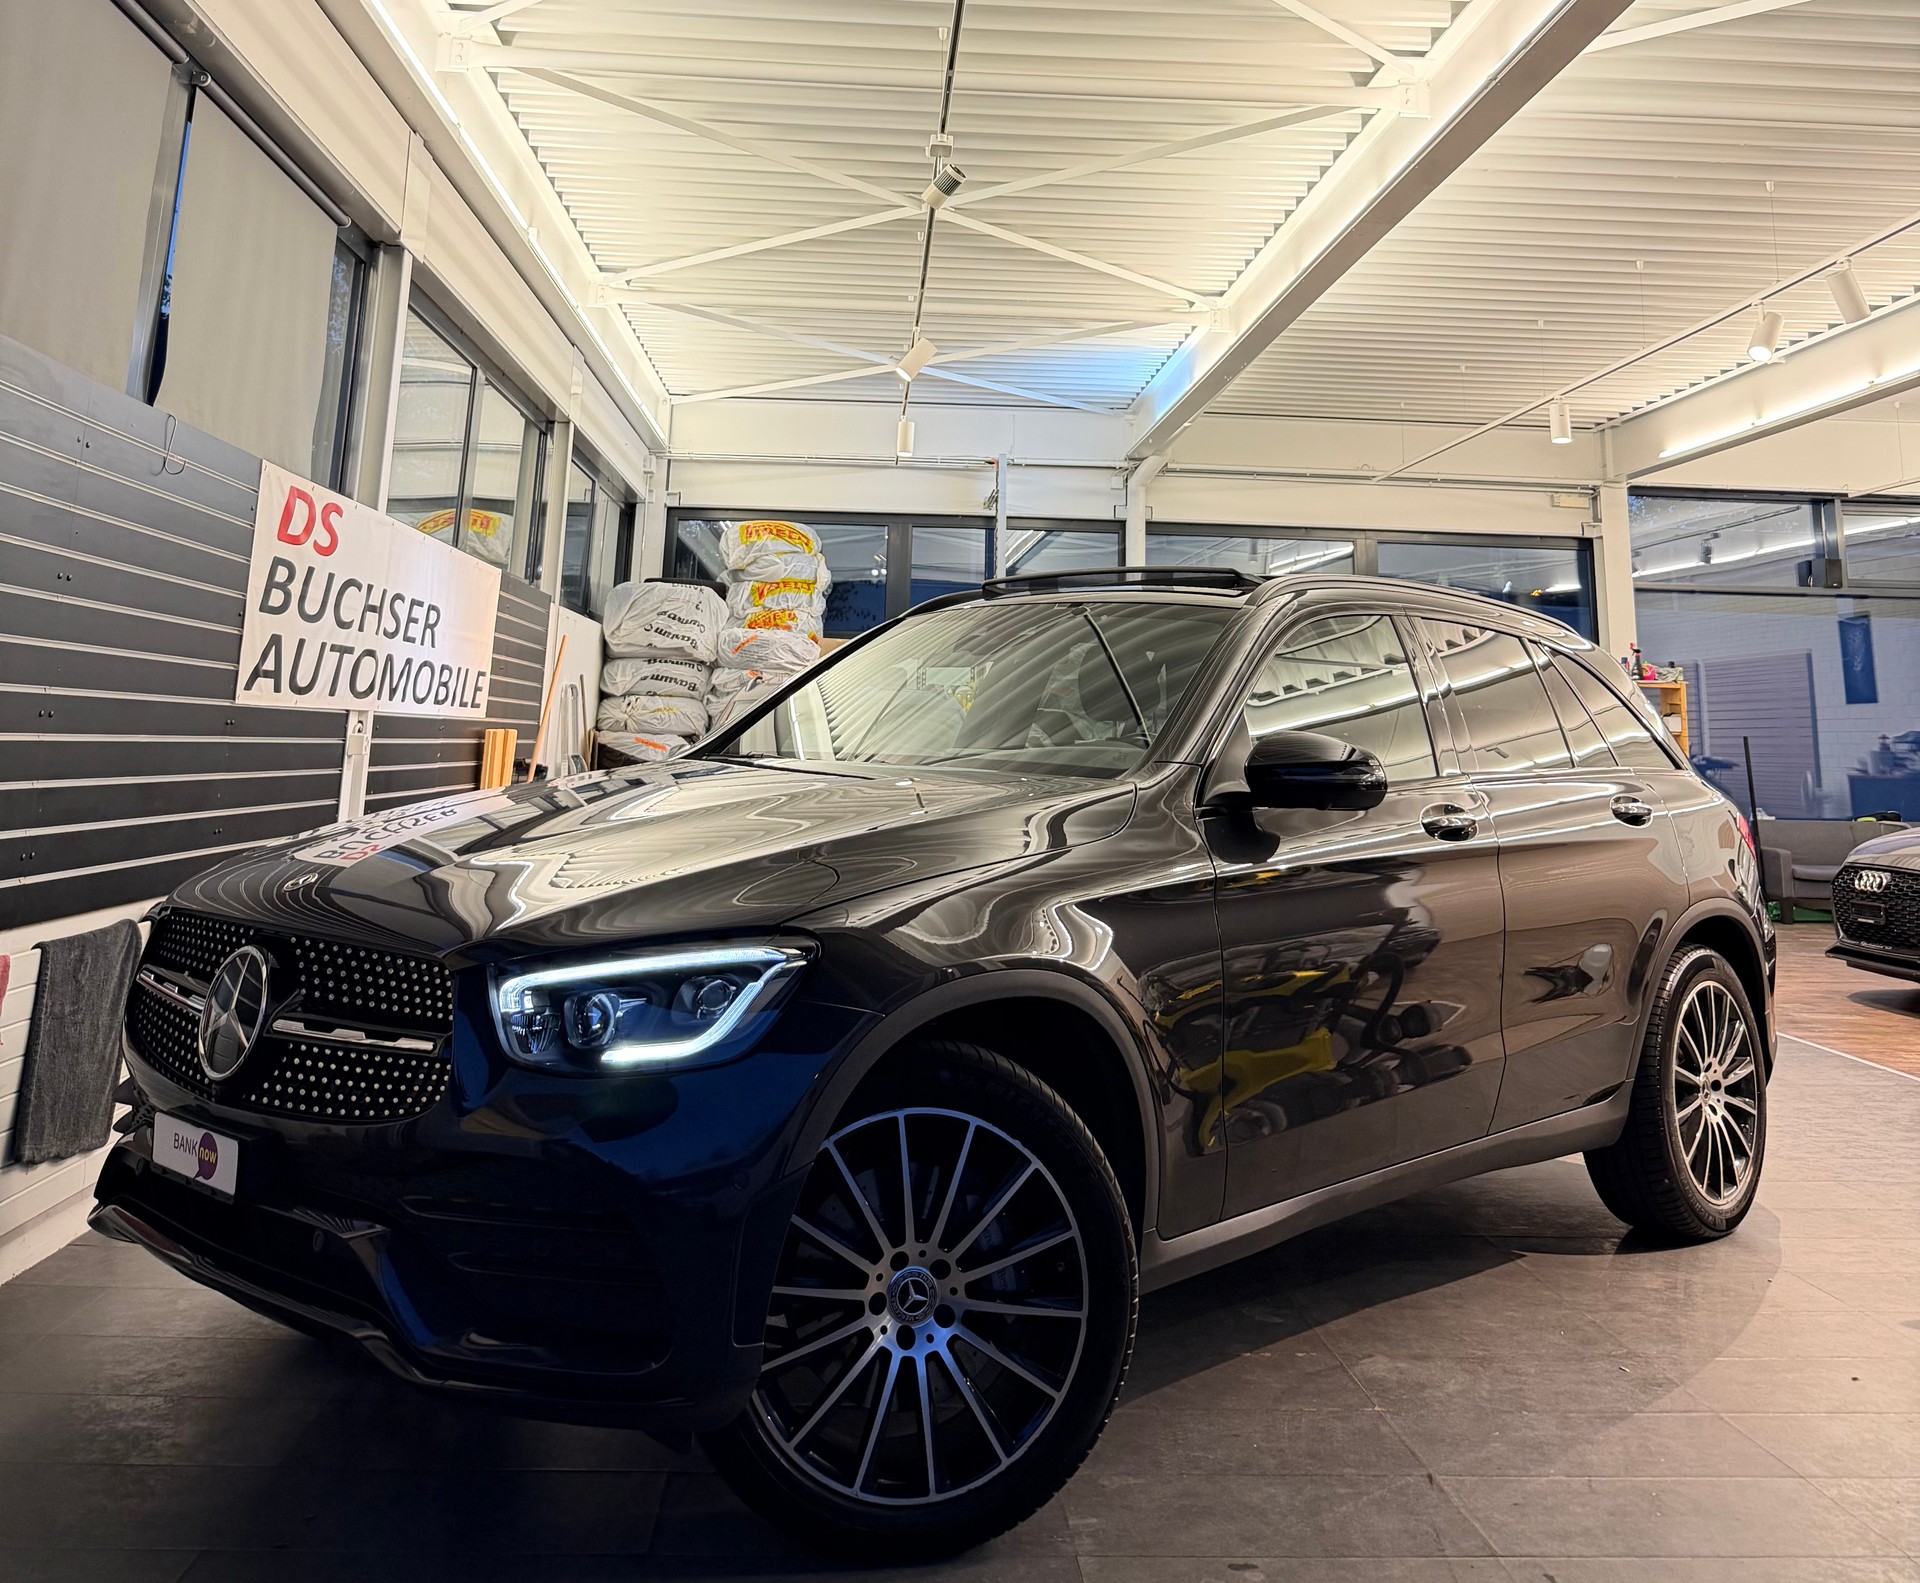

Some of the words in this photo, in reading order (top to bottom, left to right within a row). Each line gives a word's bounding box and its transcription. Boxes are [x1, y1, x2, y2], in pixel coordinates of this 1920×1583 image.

[277, 485, 344, 557] DS
[258, 555, 442, 649] BUCHSER
[243, 633, 488, 710] AUTOMOBILE
[173, 1132, 198, 1158] BANK
[198, 1147, 217, 1164] now
